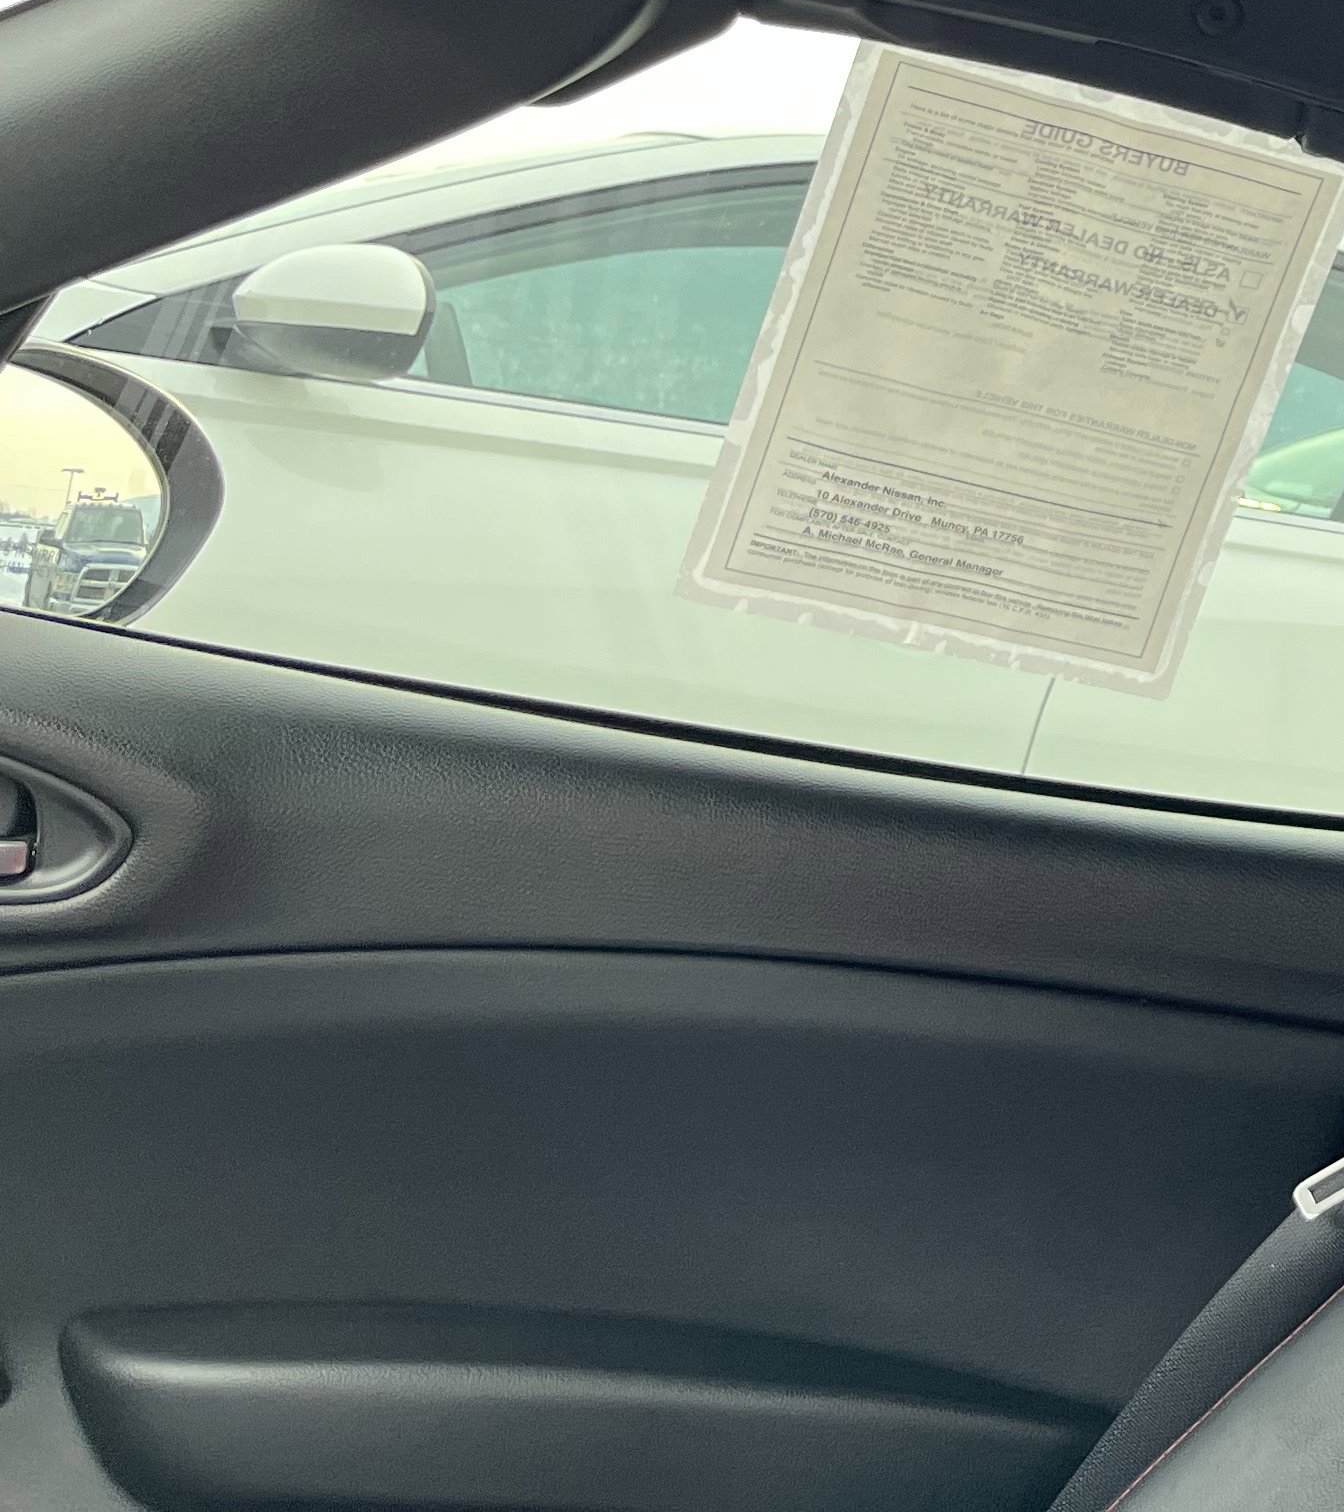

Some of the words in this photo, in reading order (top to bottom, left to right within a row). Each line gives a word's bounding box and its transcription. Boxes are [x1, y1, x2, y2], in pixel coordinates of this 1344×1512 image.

[821, 470, 880, 493] Alexander
[808, 506, 838, 524] (570)
[839, 514, 891, 535] 546-4925
[816, 489, 830, 500] 10
[832, 492, 890, 515] Alexander
[892, 508, 922, 522] Drive
[973, 526, 989, 537] PA
[991, 529, 1024, 546] 17756
[802, 526, 816, 537] A.
[818, 528, 862, 547] Michael
[864, 539, 907, 558] McRae,
[909, 549, 954, 568] General
[955, 558, 1004, 580] Manager
